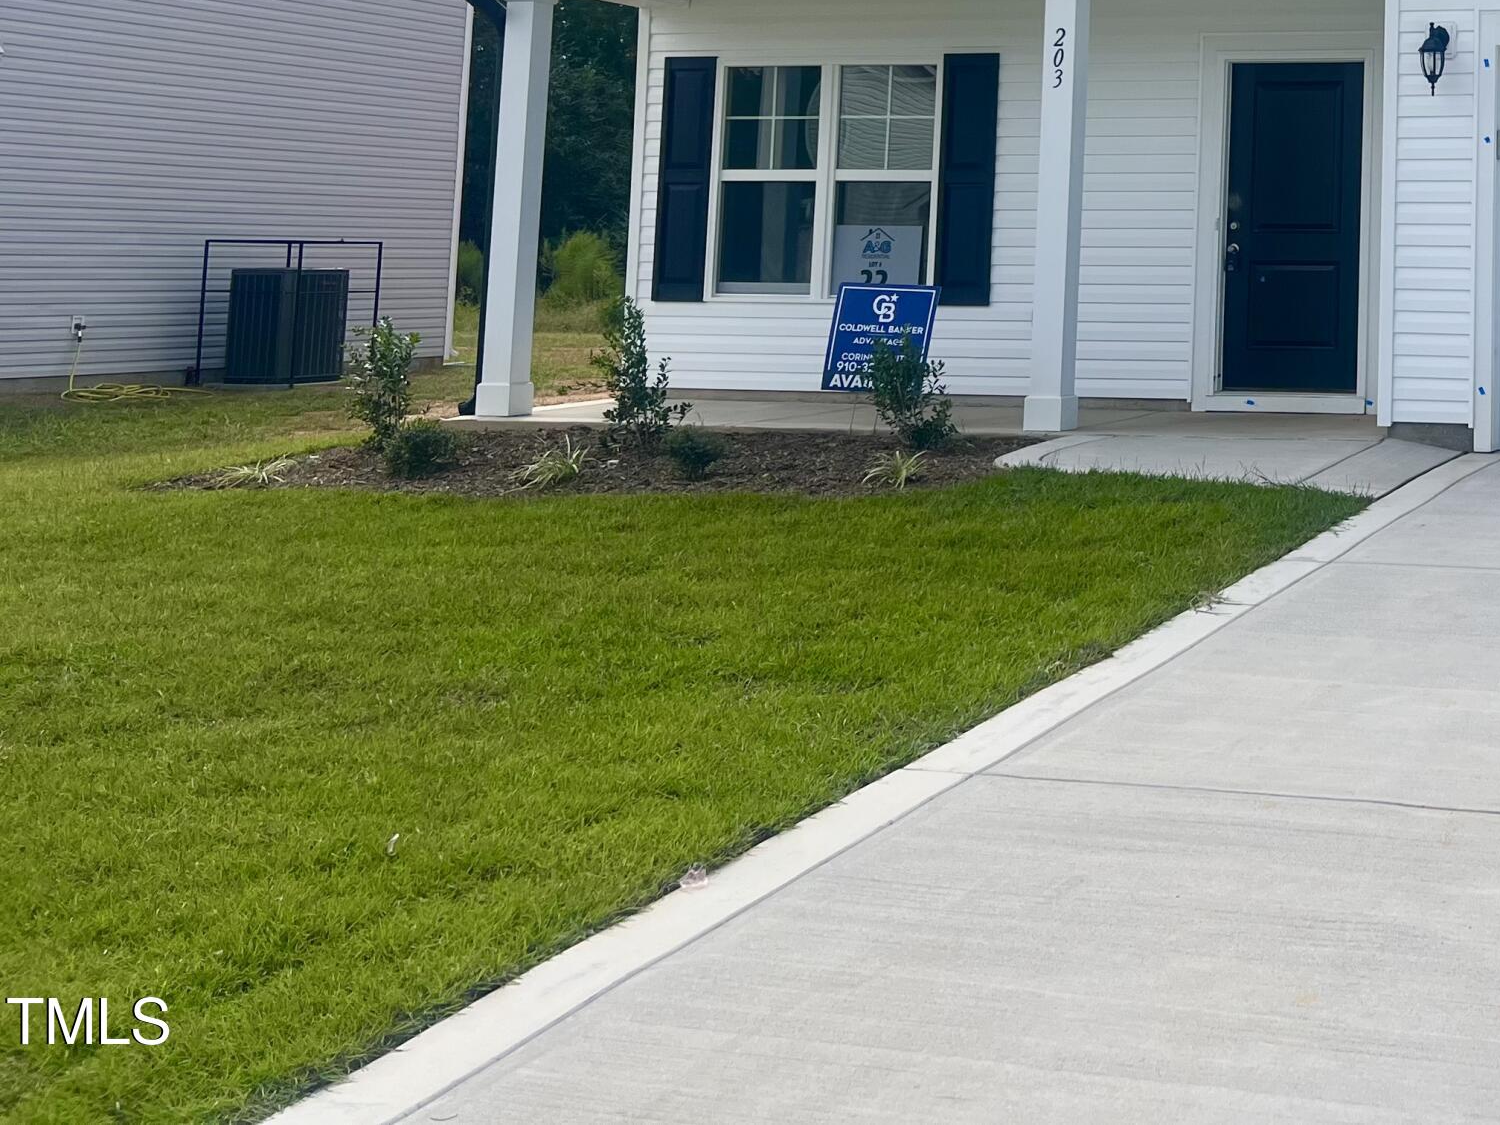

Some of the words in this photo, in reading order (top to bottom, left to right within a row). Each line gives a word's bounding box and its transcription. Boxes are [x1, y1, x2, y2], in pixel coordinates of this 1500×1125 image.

[1052, 27, 1066, 89] 203
[839, 323, 886, 333] COLDWELL
[853, 337, 904, 347] ADVTAGE
